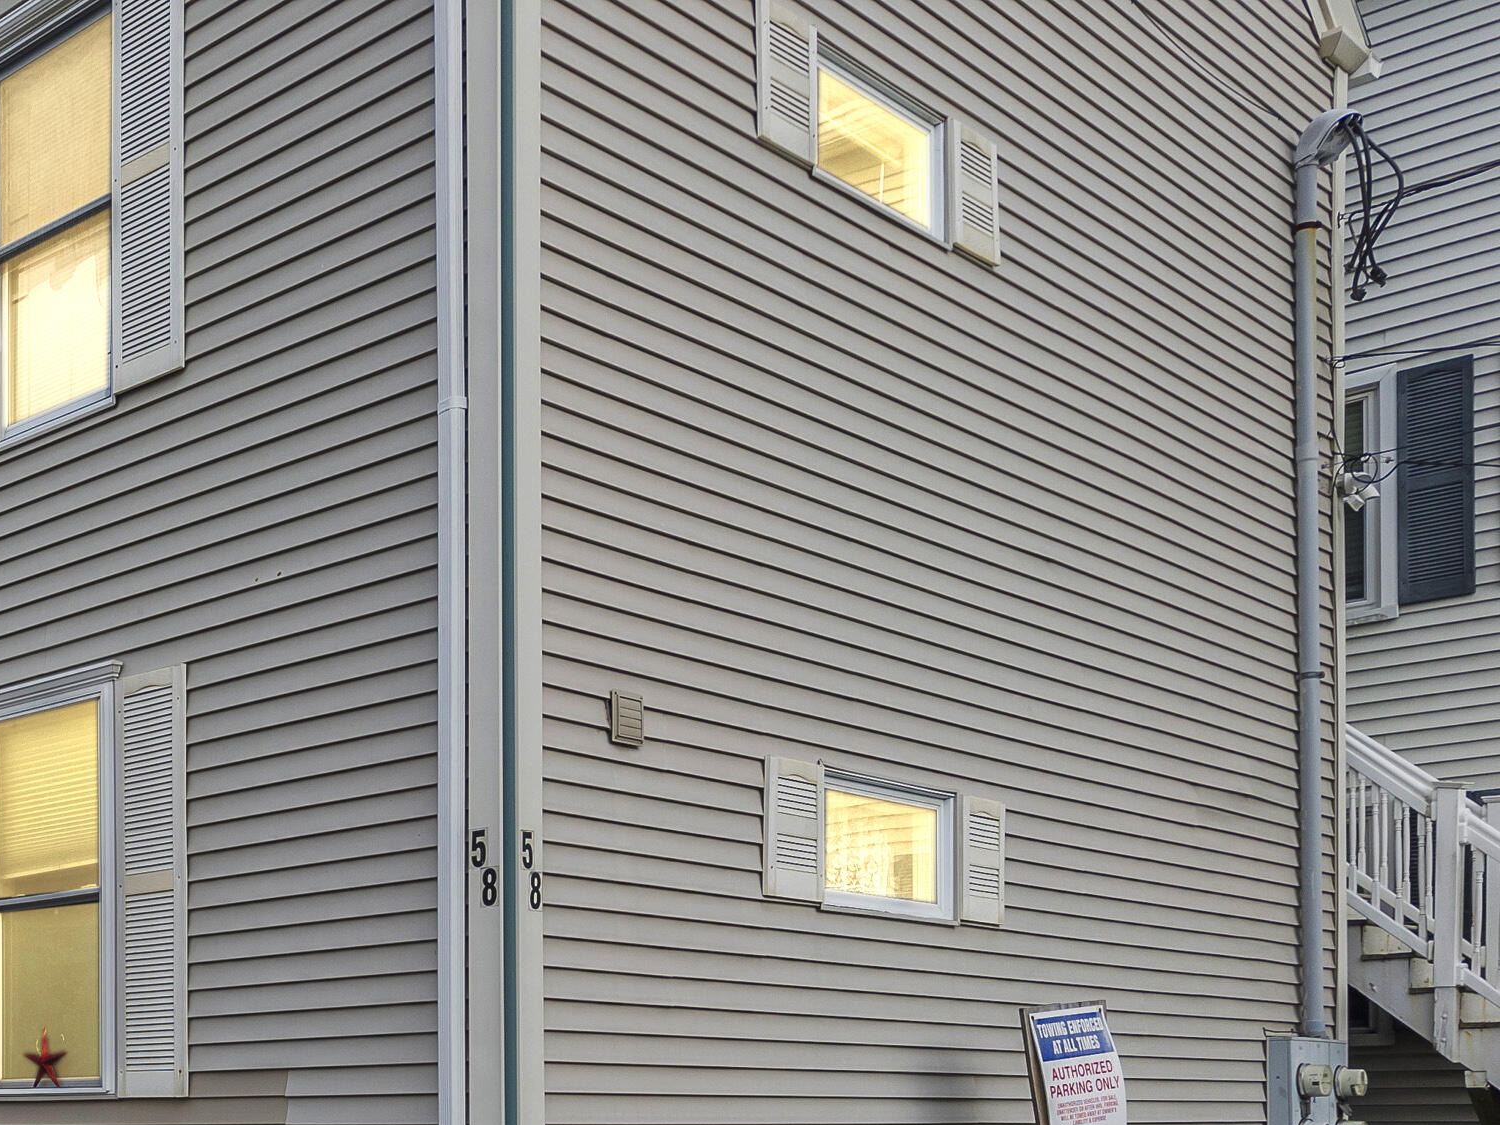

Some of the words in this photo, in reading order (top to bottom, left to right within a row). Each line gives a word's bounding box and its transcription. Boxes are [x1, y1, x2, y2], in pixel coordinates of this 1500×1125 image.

[1036, 1021, 1068, 1039] TOWING
[1066, 1017, 1104, 1035] ENFORCED
[1052, 1039, 1063, 1055] AT
[1062, 1037, 1078, 1053] ALL
[1075, 1034, 1101, 1051] TIMES
[1052, 1060, 1113, 1081] AUTHORIZED
[1049, 1079, 1093, 1099] PARKING
[1095, 1075, 1120, 1091] ONLY
